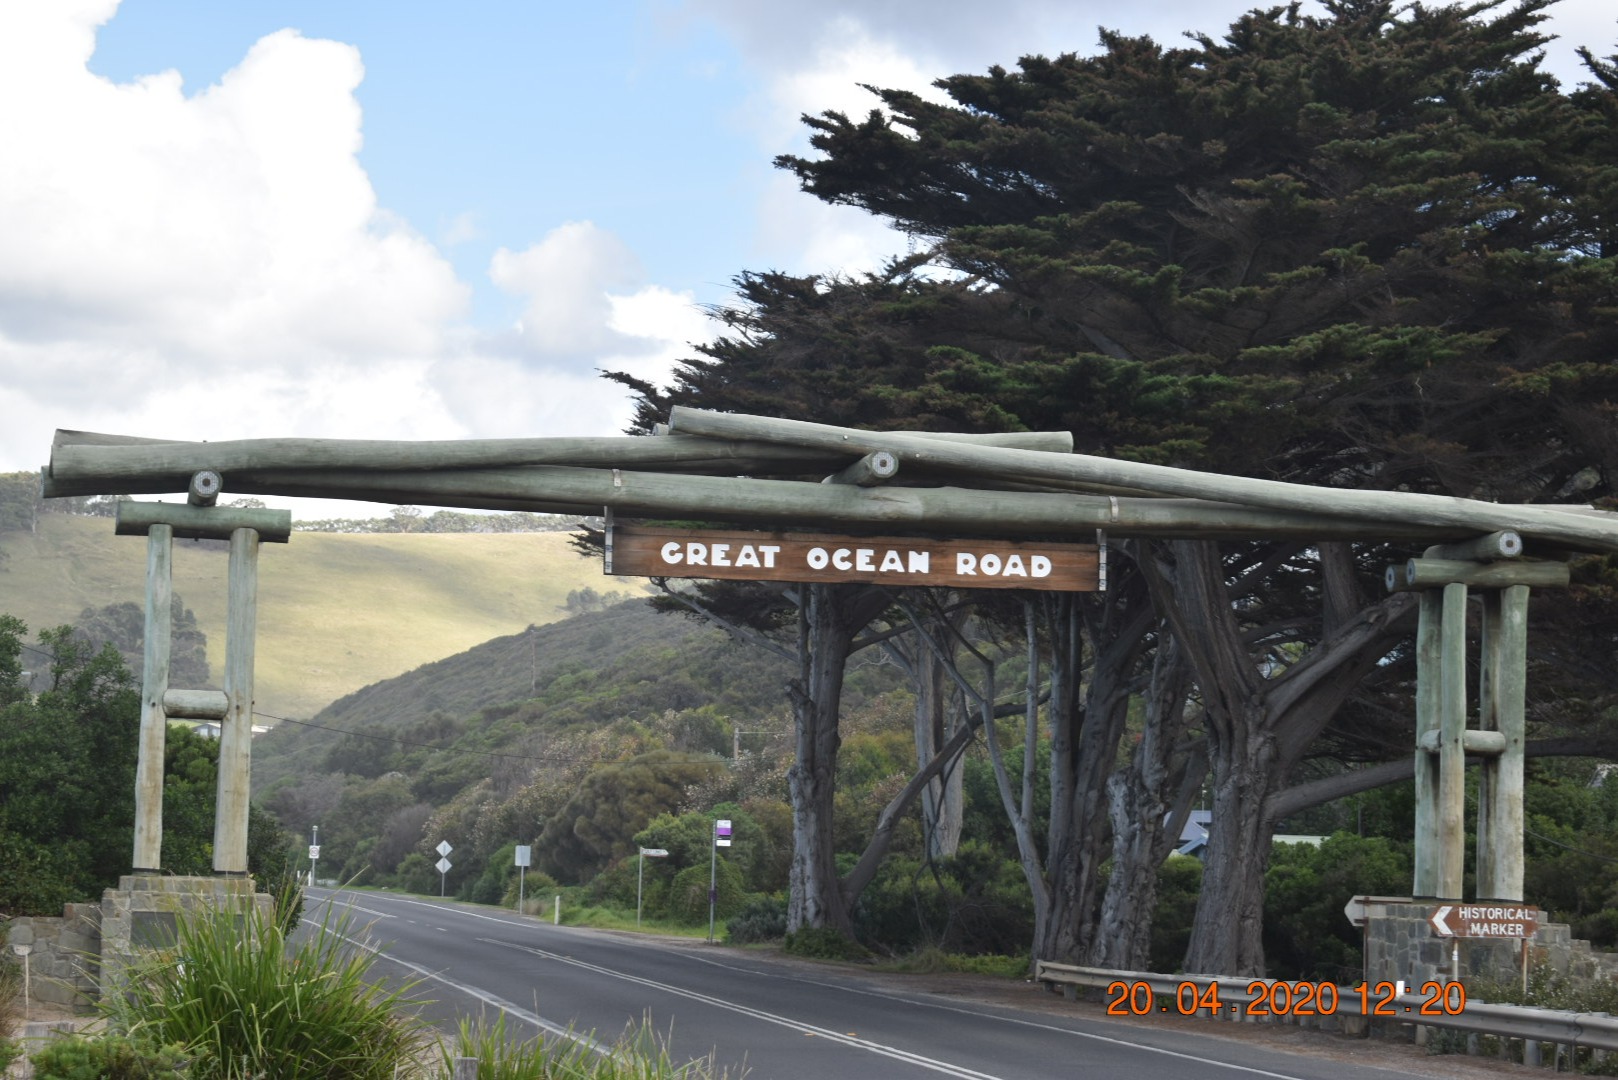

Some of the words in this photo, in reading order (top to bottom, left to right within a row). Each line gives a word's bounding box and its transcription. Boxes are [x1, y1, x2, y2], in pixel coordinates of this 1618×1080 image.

[661, 542, 780, 568] GREAT
[806, 547, 929, 574] OCEAN
[956, 552, 1052, 578] ROAD
[1458, 906, 1532, 920] HISTORICAL
[1471, 923, 1524, 936] MARKER
